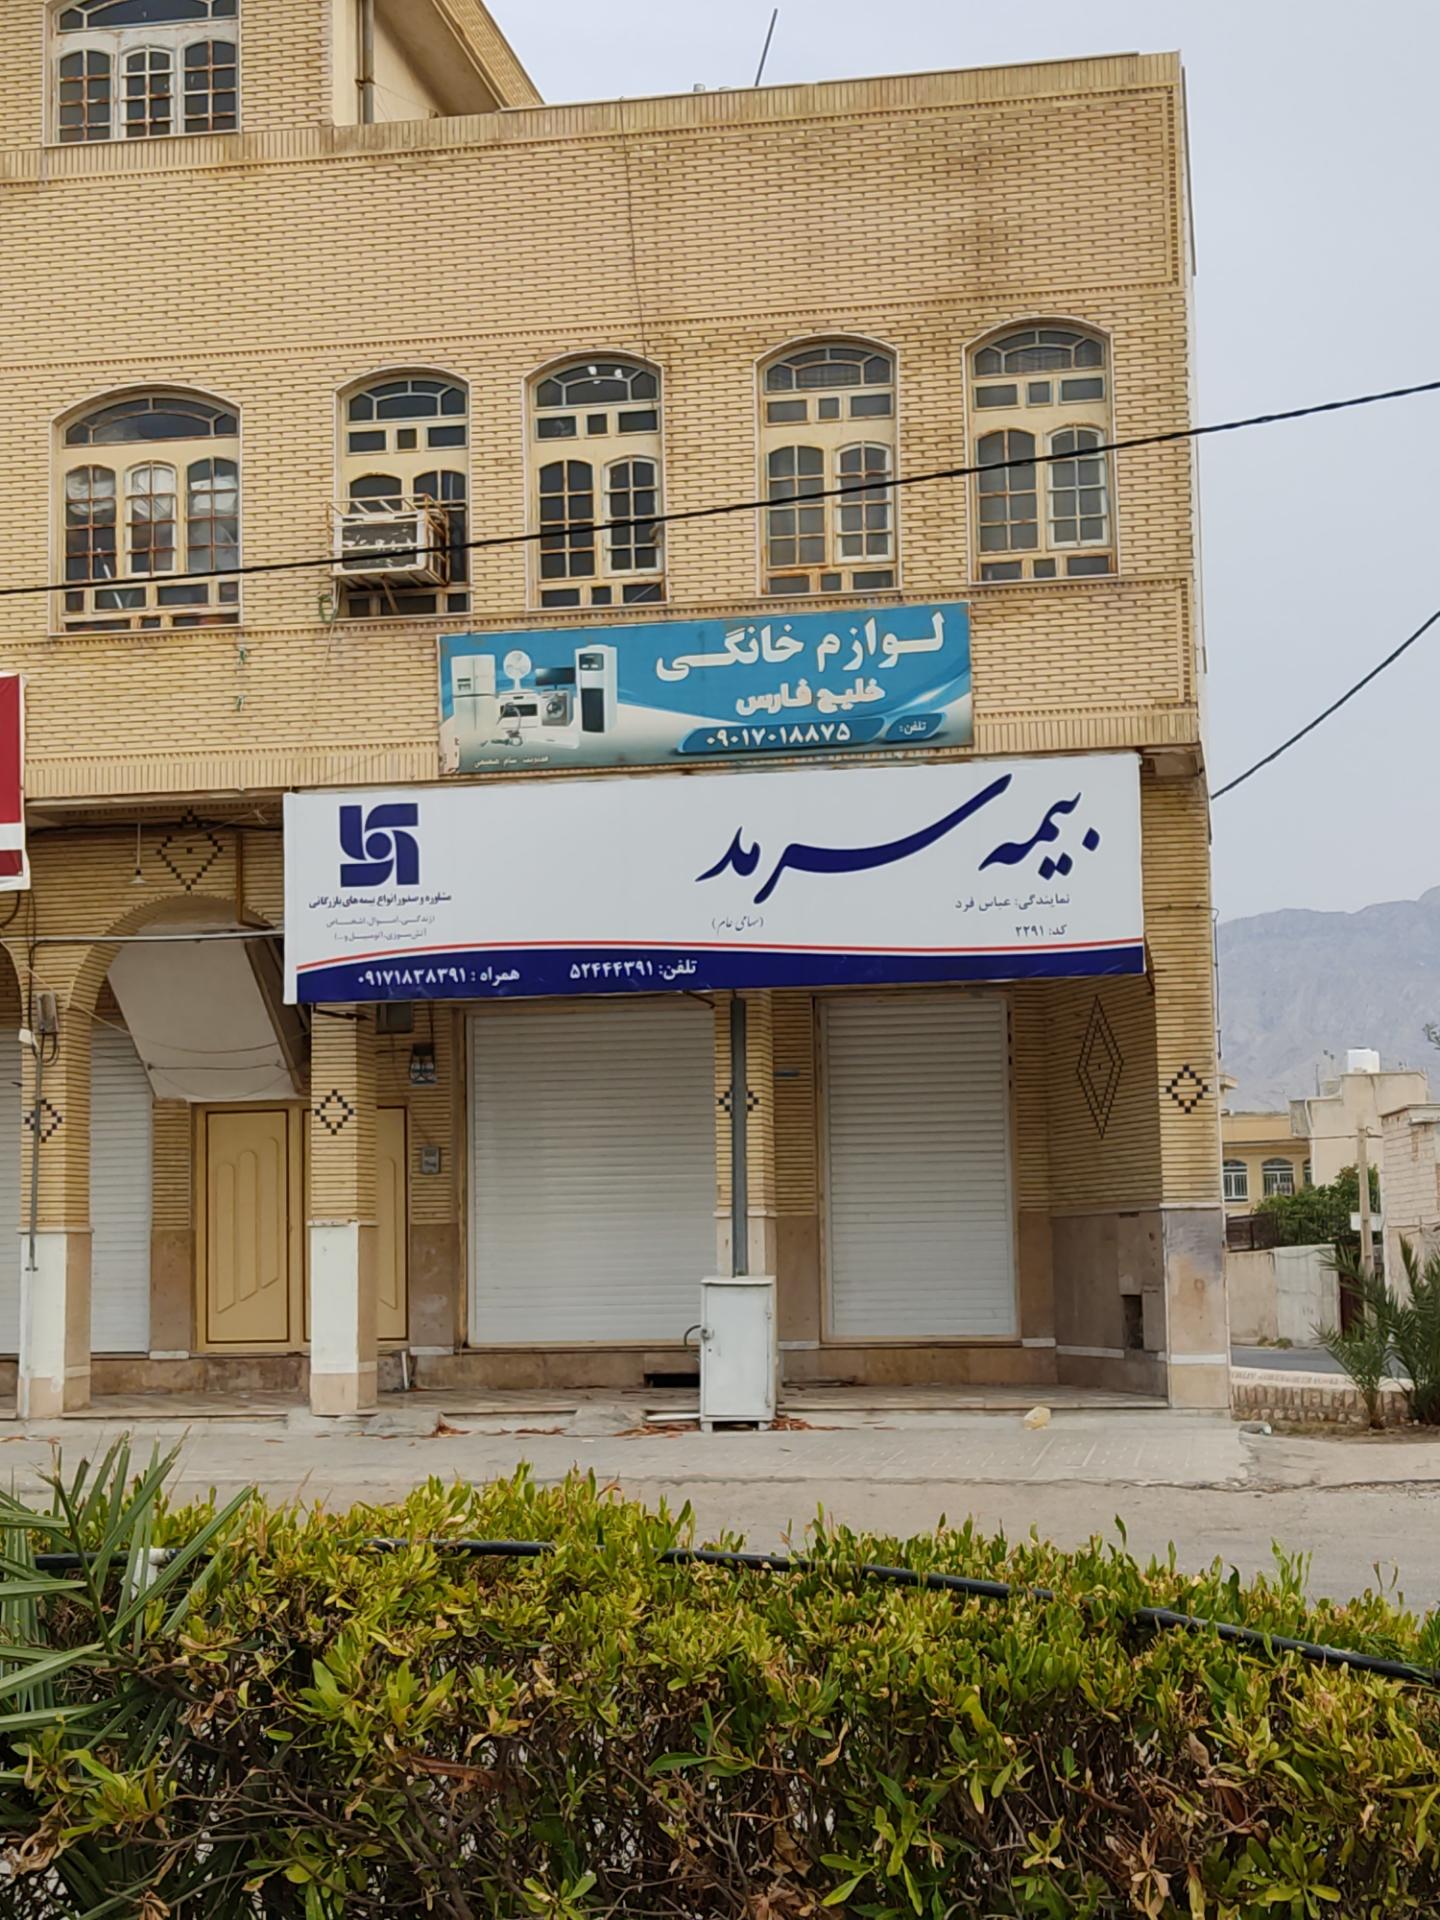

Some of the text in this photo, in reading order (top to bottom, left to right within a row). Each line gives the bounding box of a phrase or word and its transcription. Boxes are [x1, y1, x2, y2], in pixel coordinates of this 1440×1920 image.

[655, 611, 945, 682] لوازم خانگی
[735, 676, 886, 716] خلیج فارس
[706, 720, 927, 747] تلفن: ۰۹۰۱۷۰۱۸۸۷۵
[694, 773, 1100, 905] بیمه سرمد
[955, 893, 1070, 913] نمایندگی: عباس فرد
[1015, 925, 1045, 937] ۲۲۹۱
[358, 967, 467, 986] ۰۹۱۷۱۸۳۸۳۹۱
[569, 959, 698, 980] تلفن: ۵۲۴۴۴۳۹۱
